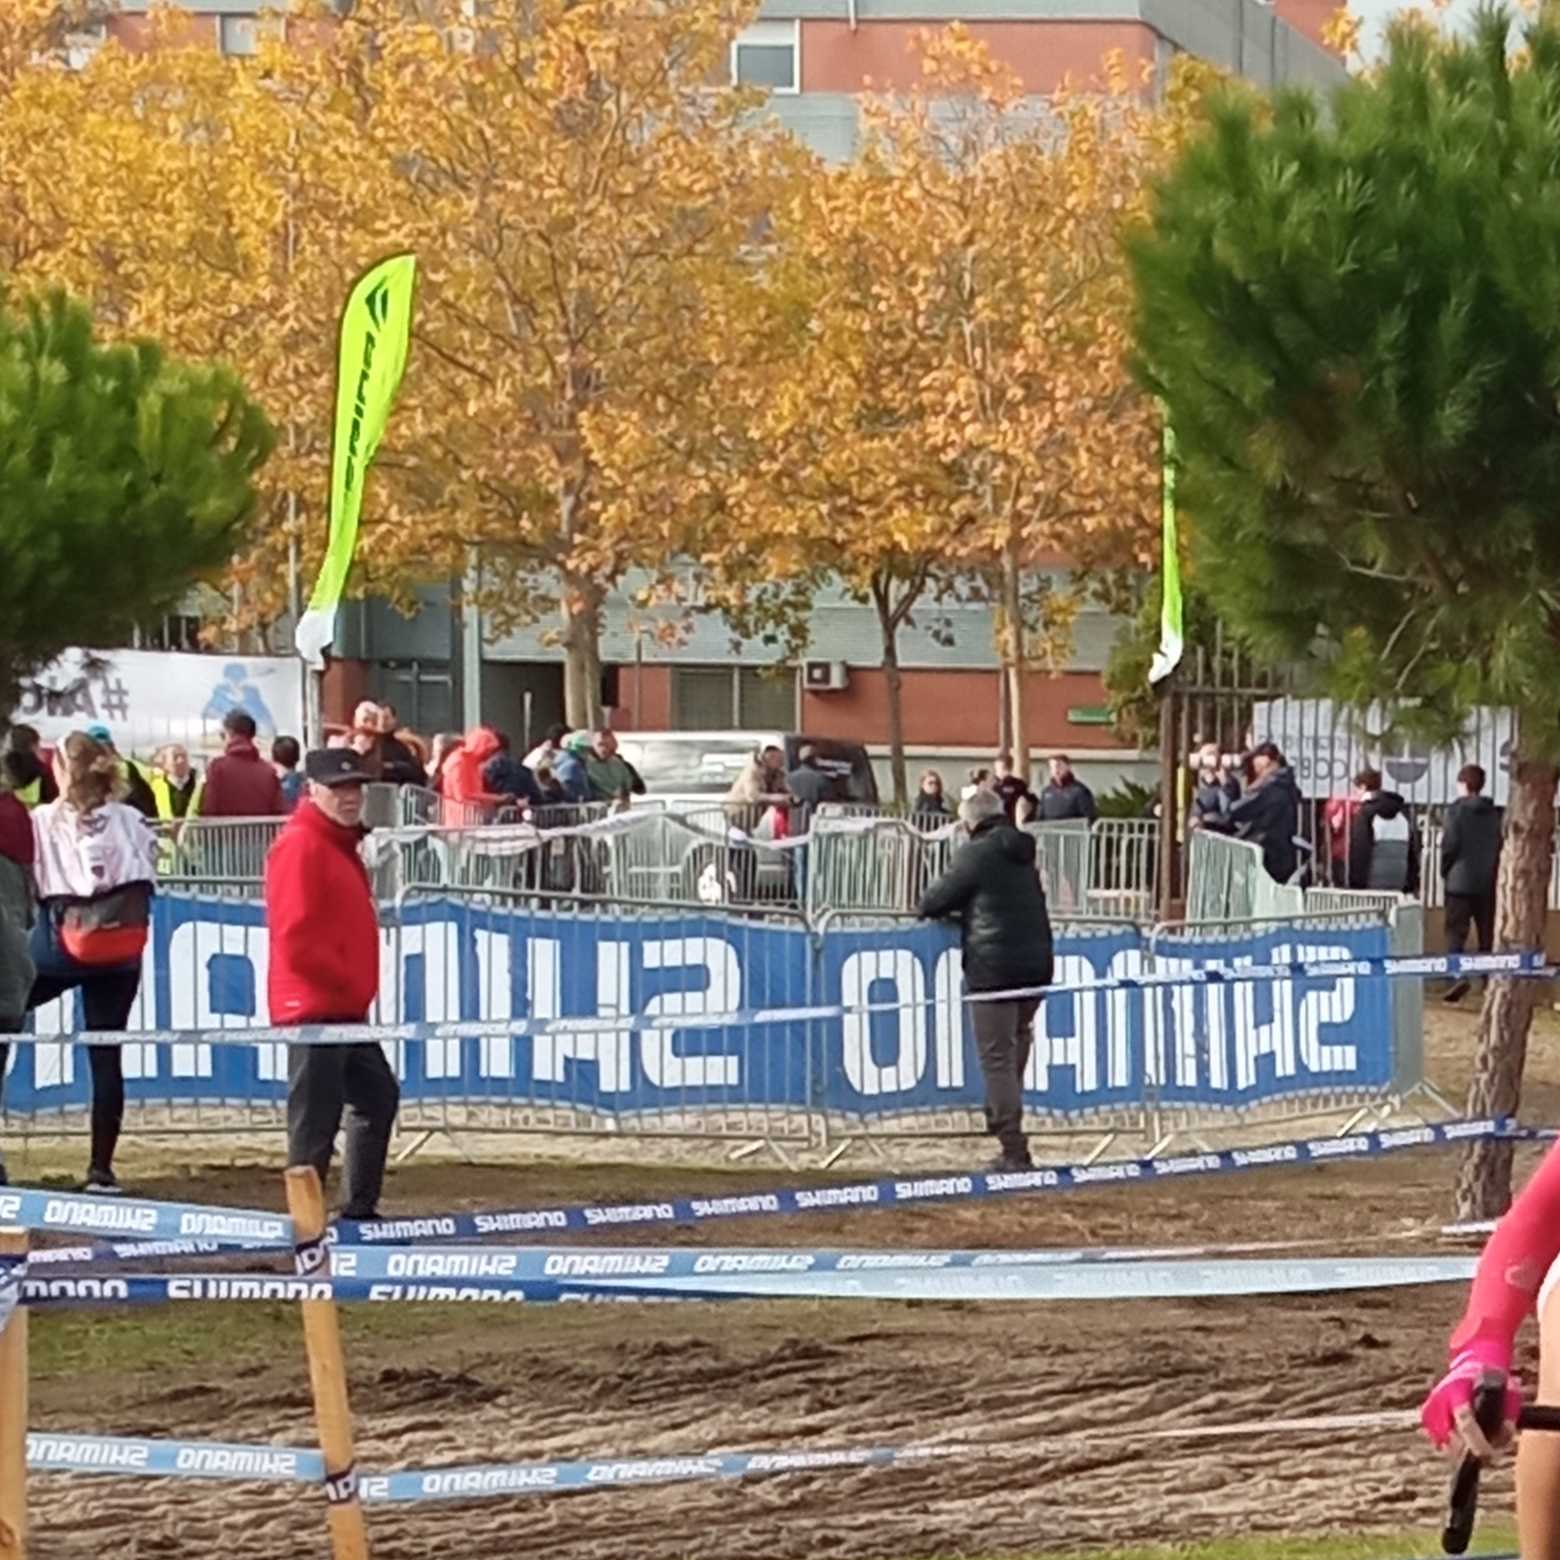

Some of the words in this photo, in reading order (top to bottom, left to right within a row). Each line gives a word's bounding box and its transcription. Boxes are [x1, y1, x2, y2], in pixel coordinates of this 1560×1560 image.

[358, 1217, 456, 1241] SHIMANO
[473, 1209, 567, 1233] SHIMANO
[584, 1203, 675, 1225] SHIMANO
[690, 1194, 780, 1217] SHIMANO
[795, 1184, 880, 1209] SHIMANO
[895, 1176, 973, 1200] SHIMANO
